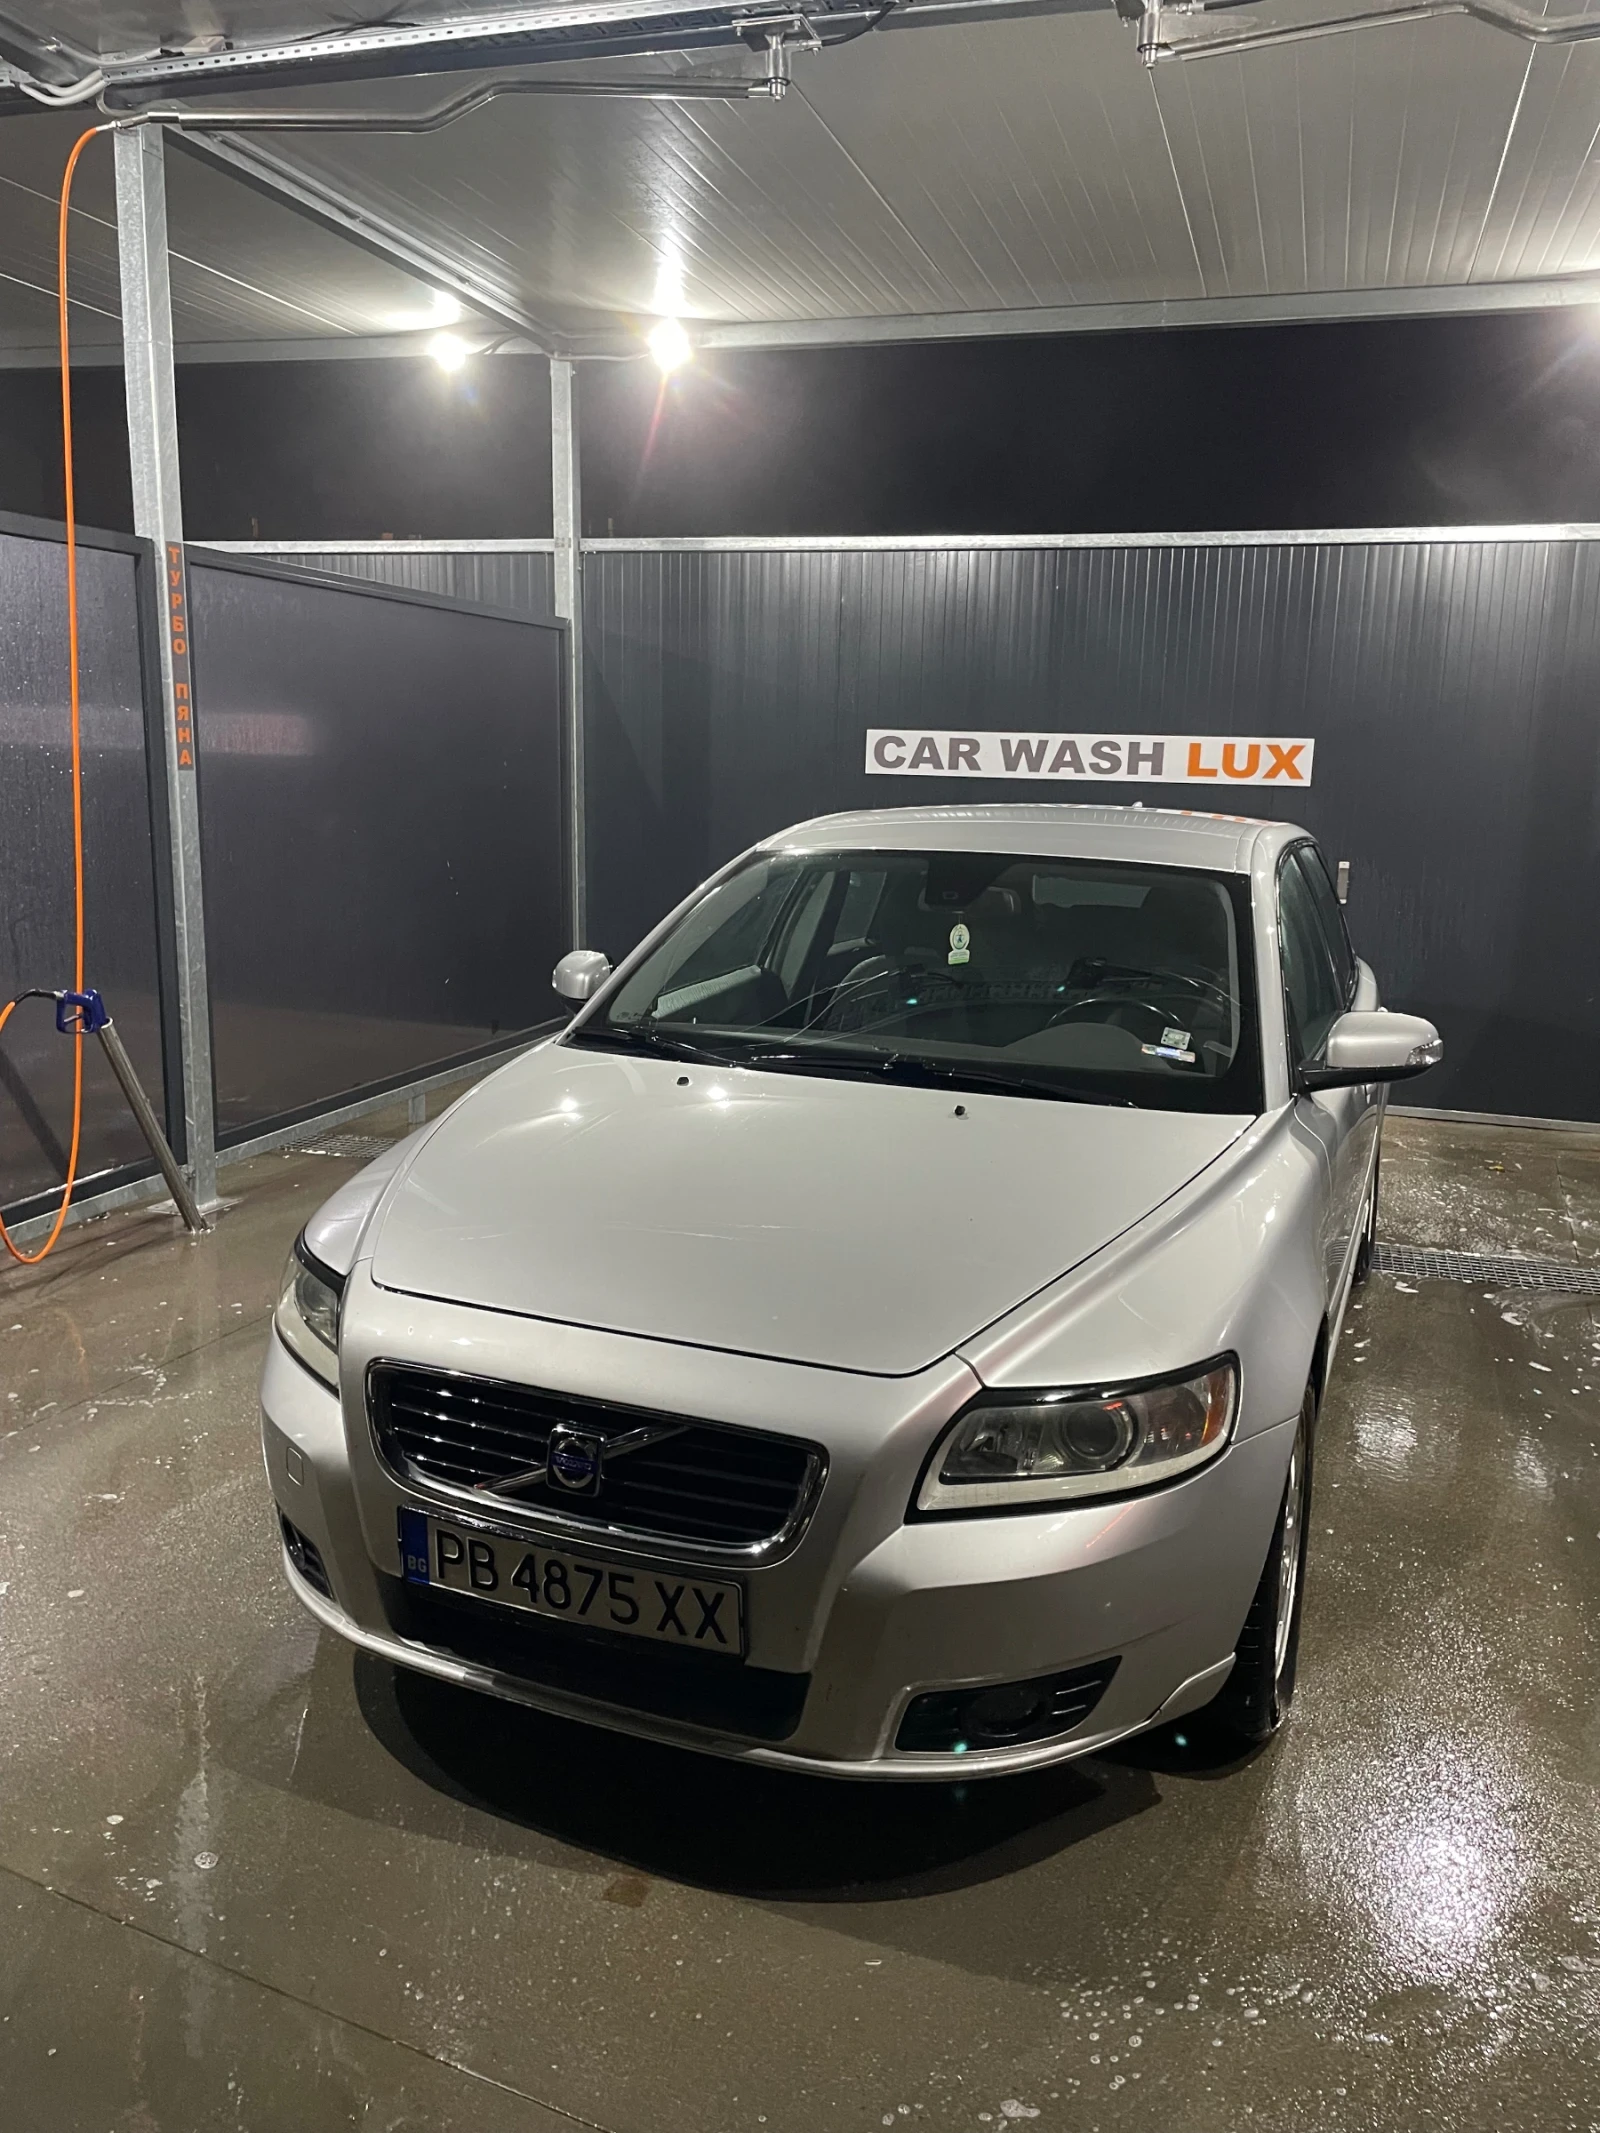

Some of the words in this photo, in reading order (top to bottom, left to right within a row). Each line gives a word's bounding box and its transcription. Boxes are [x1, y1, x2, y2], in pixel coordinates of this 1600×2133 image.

[168, 546, 187, 655] ТУРБО
[175, 683, 192, 766] ПЯНА
[873, 735, 982, 771] CAR
[1001, 738, 1165, 776] WASH
[1187, 743, 1305, 780] LUX
[407, 1554, 428, 1574] BG
[435, 1530, 499, 1592] PB
[511, 1554, 640, 1625] 4875
[655, 1581, 727, 1644] XX
